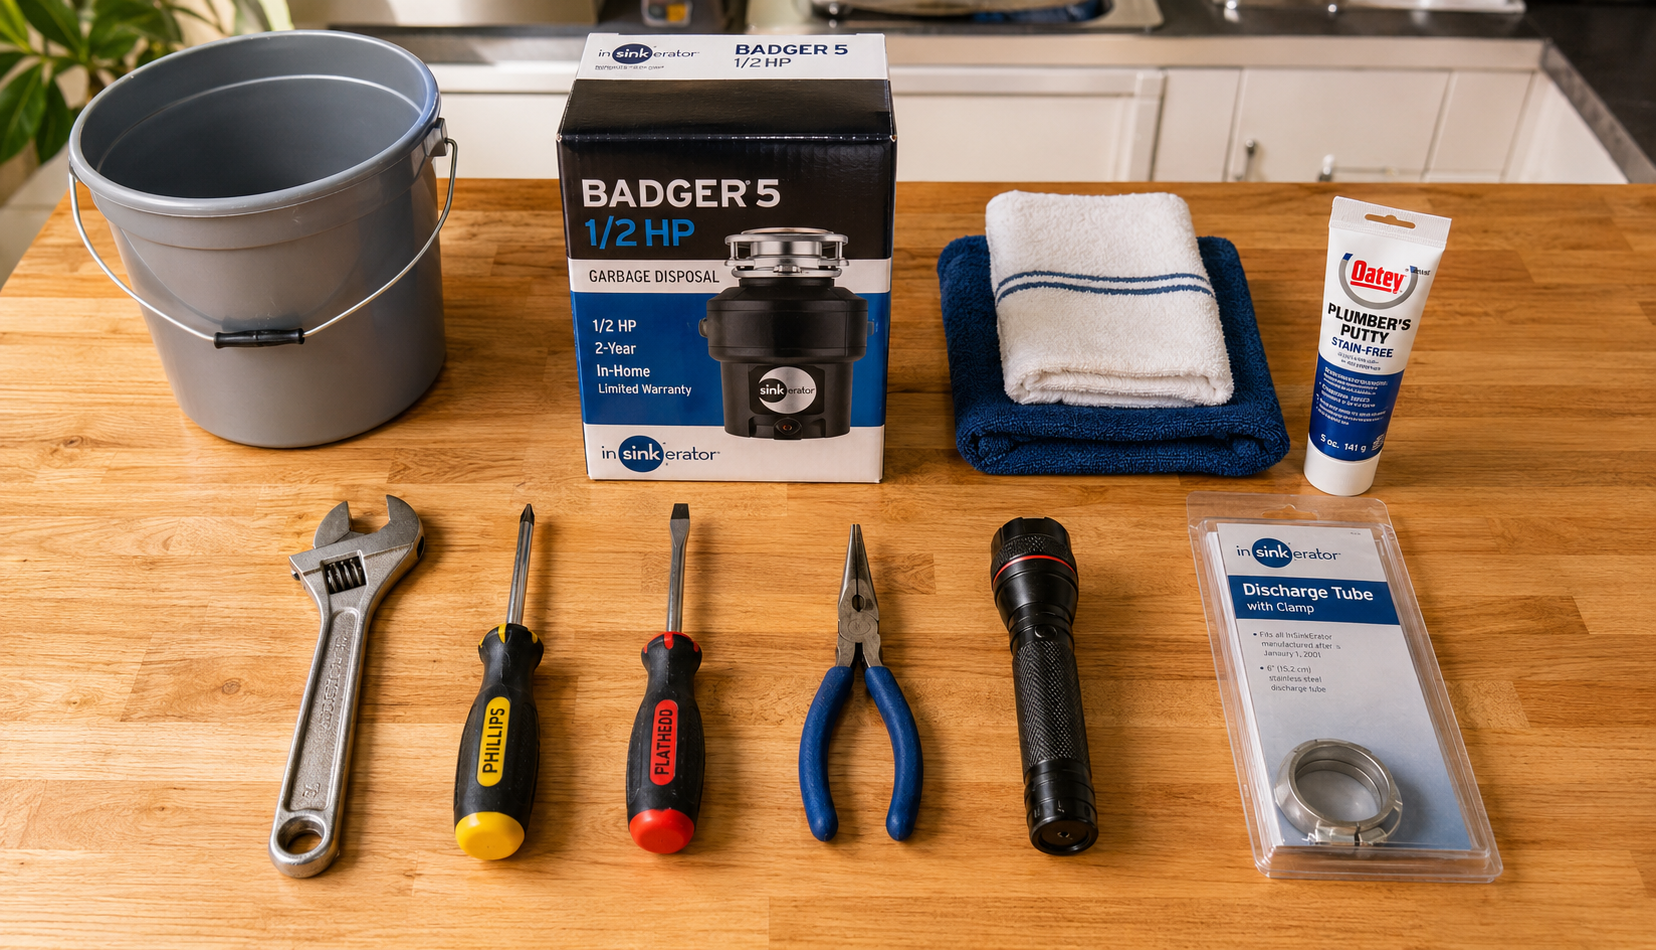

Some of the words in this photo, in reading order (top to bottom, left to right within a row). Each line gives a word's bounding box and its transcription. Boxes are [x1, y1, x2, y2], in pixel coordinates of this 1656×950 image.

[615, 47, 650, 59] sink
[735, 44, 828, 55] BADGER
[834, 44, 849, 55] 5
[734, 57, 761, 68] 1/2
[765, 57, 792, 68] HP
[582, 178, 748, 208] BADGER
[756, 178, 781, 208] 5
[585, 215, 638, 250] 1/2
[645, 218, 695, 247] HP
[589, 269, 652, 283] GARBAGE
[655, 269, 720, 283] DISPOSAL
[1351, 260, 1405, 294] Oatey
[1328, 302, 1412, 331] PLUMBER'S
[592, 319, 614, 333] 1/2
[618, 319, 637, 333] HP
[1340, 323, 1390, 345] PUTTY
[595, 341, 637, 355] 2-Year
[1331, 336, 1394, 358] STAIN-FREE
[596, 364, 651, 378] In-Home
[598, 383, 639, 395] Limited
[641, 383, 692, 397] Warranty
[759, 382, 785, 396] sink
[786, 386, 816, 395] erator
[622, 442, 661, 461] sink
[665, 446, 717, 461] erator
[1344, 442, 1359, 452] 141
[1360, 445, 1367, 453] g
[1255, 544, 1290, 559] sink
[1294, 548, 1338, 561] erator
[1242, 582, 1329, 601] Discharge
[1331, 586, 1374, 601] Tube
[1246, 601, 1274, 612] with
[1276, 602, 1315, 615] Clamp
[1261, 640, 1314, 649] manufactured
[1296, 665, 1312, 674] cm)
[1270, 683, 1307, 693] discharge
[482, 707, 505, 774] PHILLIPS
